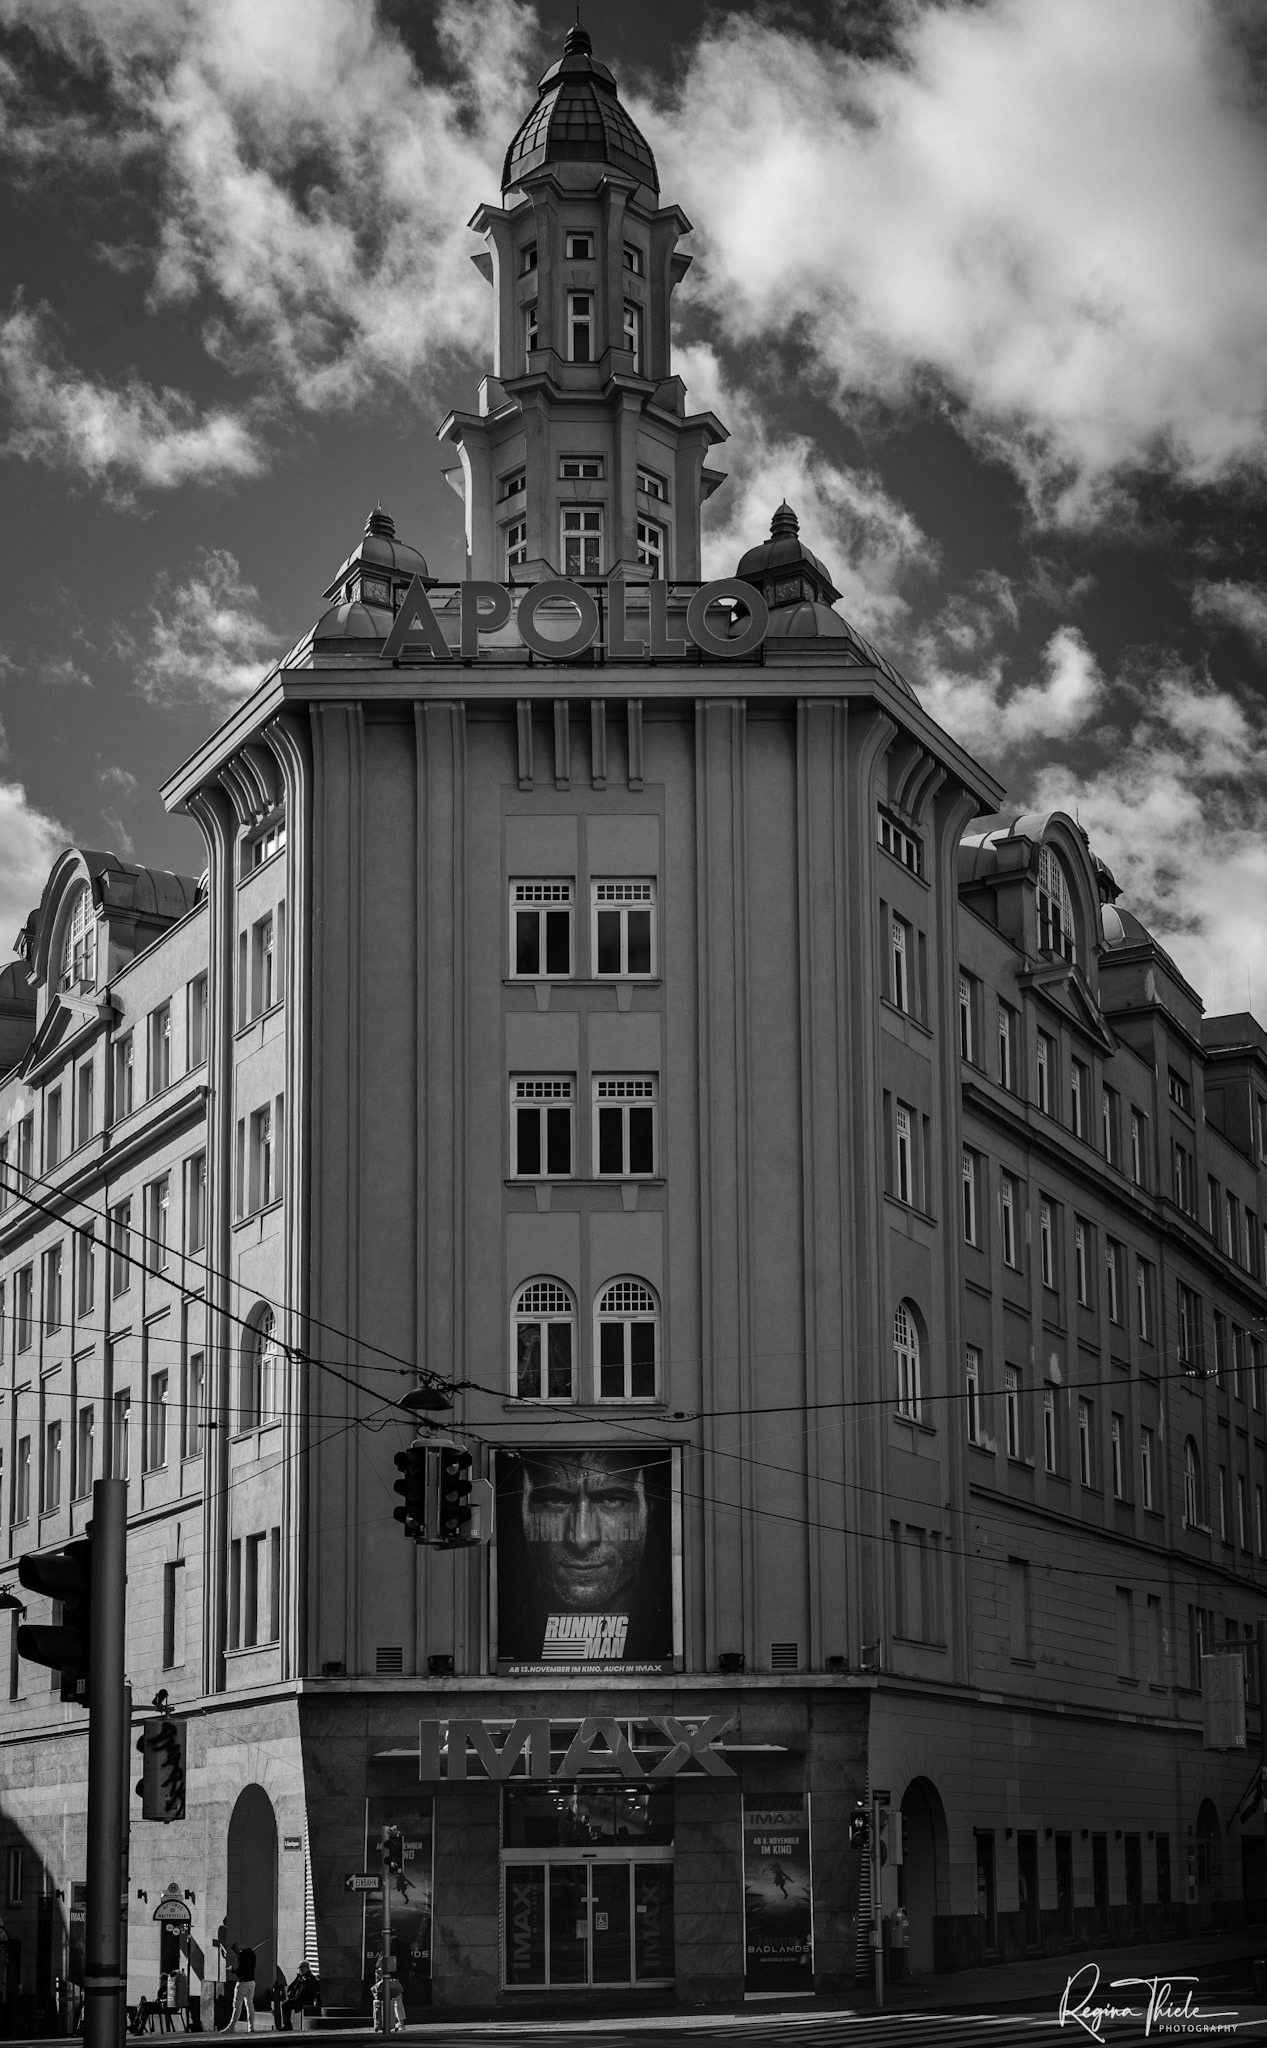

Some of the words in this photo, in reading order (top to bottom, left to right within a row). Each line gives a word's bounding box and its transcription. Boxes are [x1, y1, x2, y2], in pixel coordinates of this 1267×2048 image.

[379, 573, 770, 660] APOLLO
[529, 1513, 564, 1542] HOLT
[601, 1513, 640, 1542] EUCH
[545, 1615, 629, 1638] RUNNING
[584, 1638, 627, 1659] MAN
[582, 1665, 602, 1673] KINO.
[419, 1715, 738, 1781] IMAX
[1237, 1736, 1245, 1744] 10
[750, 1814, 802, 1825] IMAX
[761, 1845, 771, 1854] IM
[773, 1845, 792, 1854] KINO
[355, 1878, 377, 1887] EINBAHN
[70, 1912, 86, 1922] IMAX
[642, 1880, 660, 1967] IMAX
[513, 1884, 531, 1969] IMAX
[748, 1945, 810, 1953] BADLANDS
